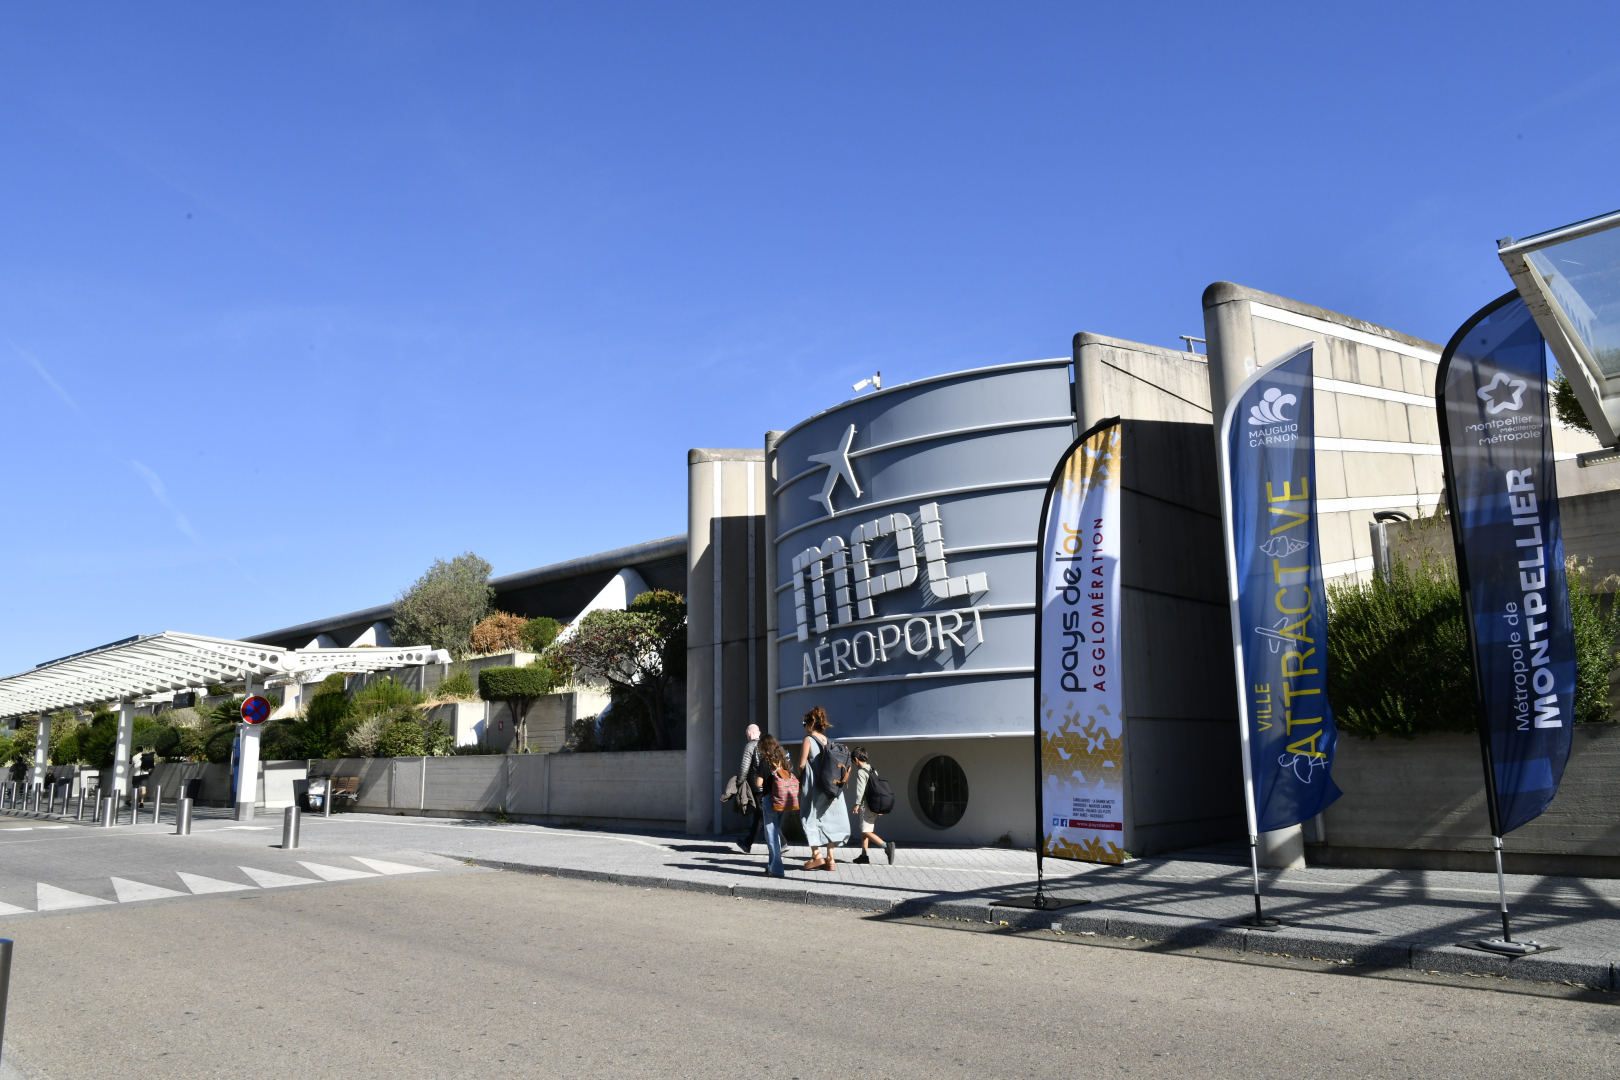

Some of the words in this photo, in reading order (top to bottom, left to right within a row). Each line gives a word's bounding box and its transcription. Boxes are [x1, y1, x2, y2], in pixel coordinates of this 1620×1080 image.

[1249, 424, 1298, 439] MAUGUIO
[1249, 433, 1299, 448] CARNON
[1088, 518, 1106, 692] AGGLOMÉRATION
[1265, 476, 1327, 759] ATTRACTVE
[1502, 601, 1519, 626] de
[1505, 467, 1562, 729] MONTPELLIER
[802, 604, 990, 686] AÉROPORT
[1060, 610, 1087, 693] pays
[1504, 631, 1530, 731] Métropole
[1254, 683, 1273, 732] VILLE
